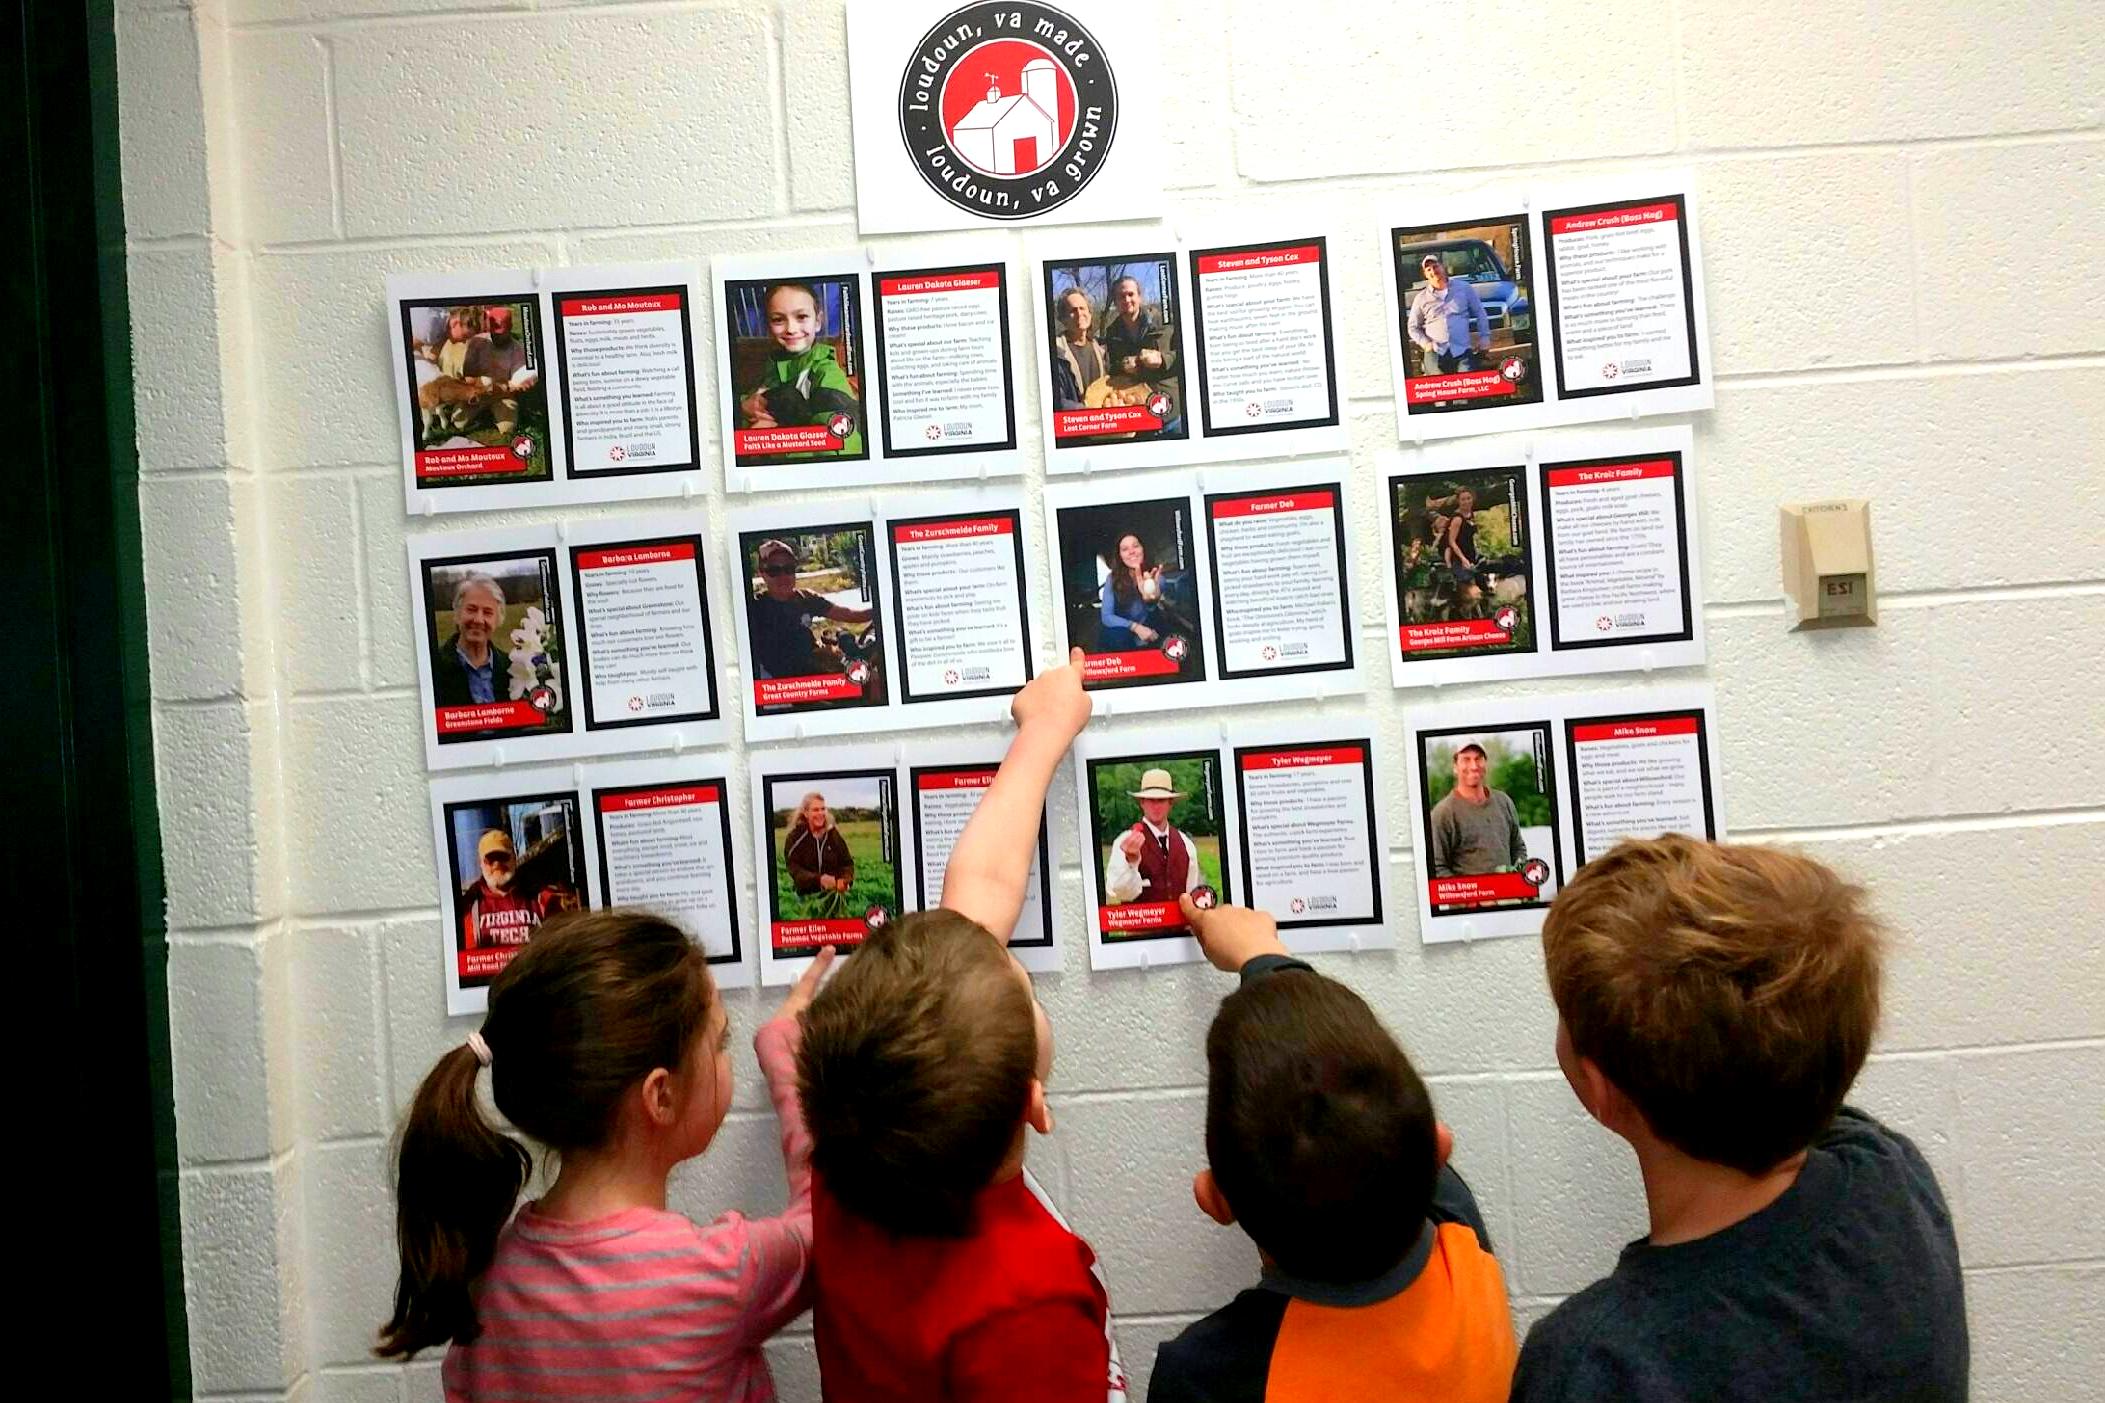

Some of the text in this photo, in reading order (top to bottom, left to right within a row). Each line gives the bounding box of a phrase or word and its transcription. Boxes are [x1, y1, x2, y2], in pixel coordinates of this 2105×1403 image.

[909, 11, 1091, 111] loudoun, va made
[926, 106, 1102, 210] loudoun, va grown
[1245, 257, 1260, 266] and
[1260, 256, 1283, 266] Tyson
[925, 280, 952, 289] Dakota
[1063, 415, 1088, 424] Steven
[1089, 413, 1104, 422] and
[1105, 412, 1127, 422] Tyson
[1079, 423, 1100, 431] Corner
[744, 434, 770, 442] Lauren
[771, 432, 799, 441] Dakota
[744, 442, 761, 451] Faith
[762, 442, 776, 450] Like
[1579, 472, 1593, 480] The
[1616, 467, 1642, 477] Family
[1251, 500, 1295, 511] Farmer Deb
[910, 530, 924, 538] The
[973, 523, 998, 533] Family
[1445, 626, 1470, 635] Family
[1084, 657, 1121, 668] armer Deb
[762, 683, 776, 692] The
[822, 678, 846, 687] Family
[763, 692, 781, 700] Great
[783, 690, 808, 699] Country
[1614, 727, 1657, 736] Mike Snow
[1271, 758, 1291, 767] Tyler
[955, 778, 980, 787] Farmer
[1457, 882, 1478, 890] Snow
[1106, 911, 1126, 920] Tyler
[490, 926, 529, 944] TECH
[781, 926, 807, 936] Farmer
